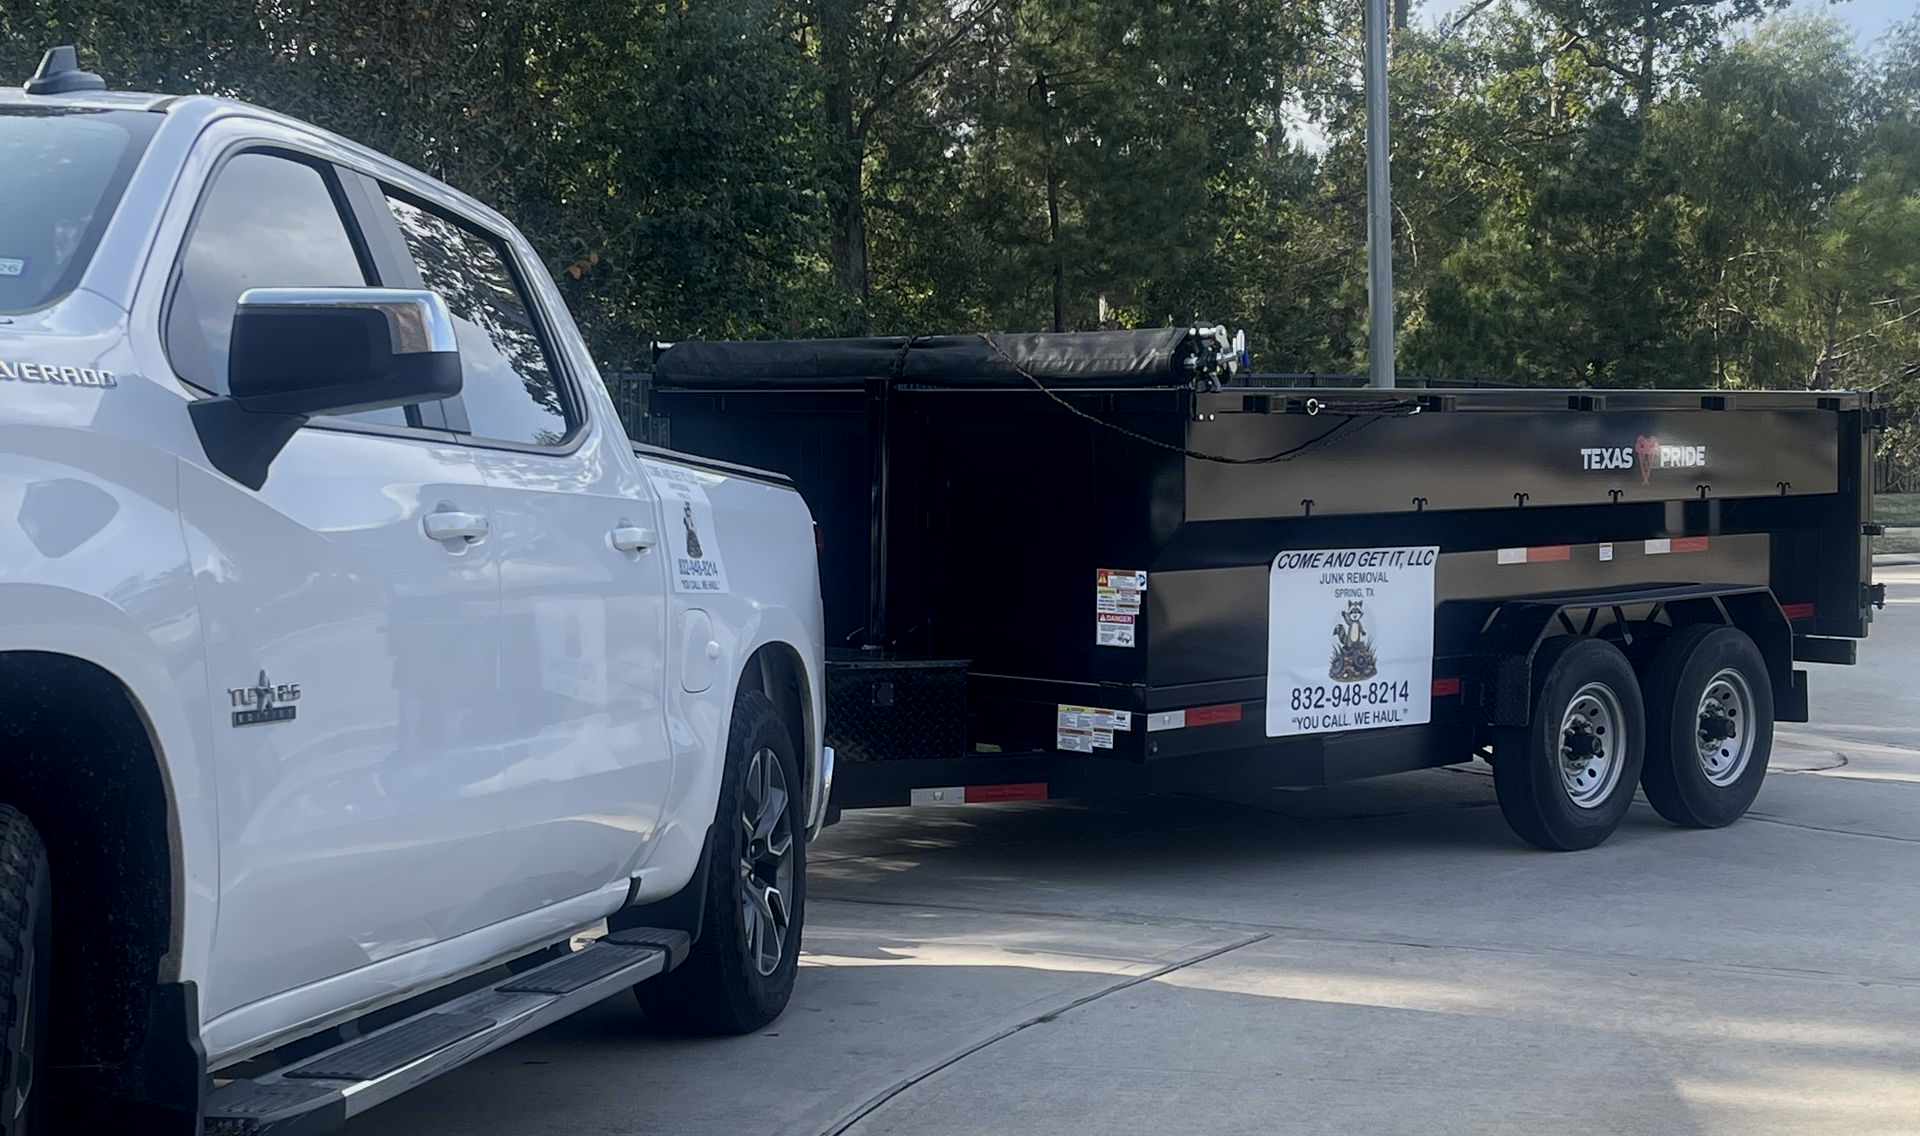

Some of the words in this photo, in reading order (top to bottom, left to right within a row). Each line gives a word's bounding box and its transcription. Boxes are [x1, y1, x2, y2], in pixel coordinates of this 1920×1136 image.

[0, 360, 118, 389] VERADO
[1580, 447, 1634, 470] TEXAS
[1660, 445, 1706, 468] PRIDE
[1277, 552, 1324, 570] COME
[1322, 551, 1356, 569] AND
[1357, 550, 1390, 568] GET
[1388, 550, 1406, 570] IT,
[1407, 549, 1435, 566] LLC
[1319, 572, 1345, 585] JUNK
[1346, 571, 1389, 584] REMOVAL
[1334, 588, 1364, 599] SPRING,
[1365, 587, 1375, 597] TX
[1106, 615, 1133, 623] DANGER
[1290, 680, 1409, 711] 832-948-8214
[1354, 711, 1371, 725] WE
